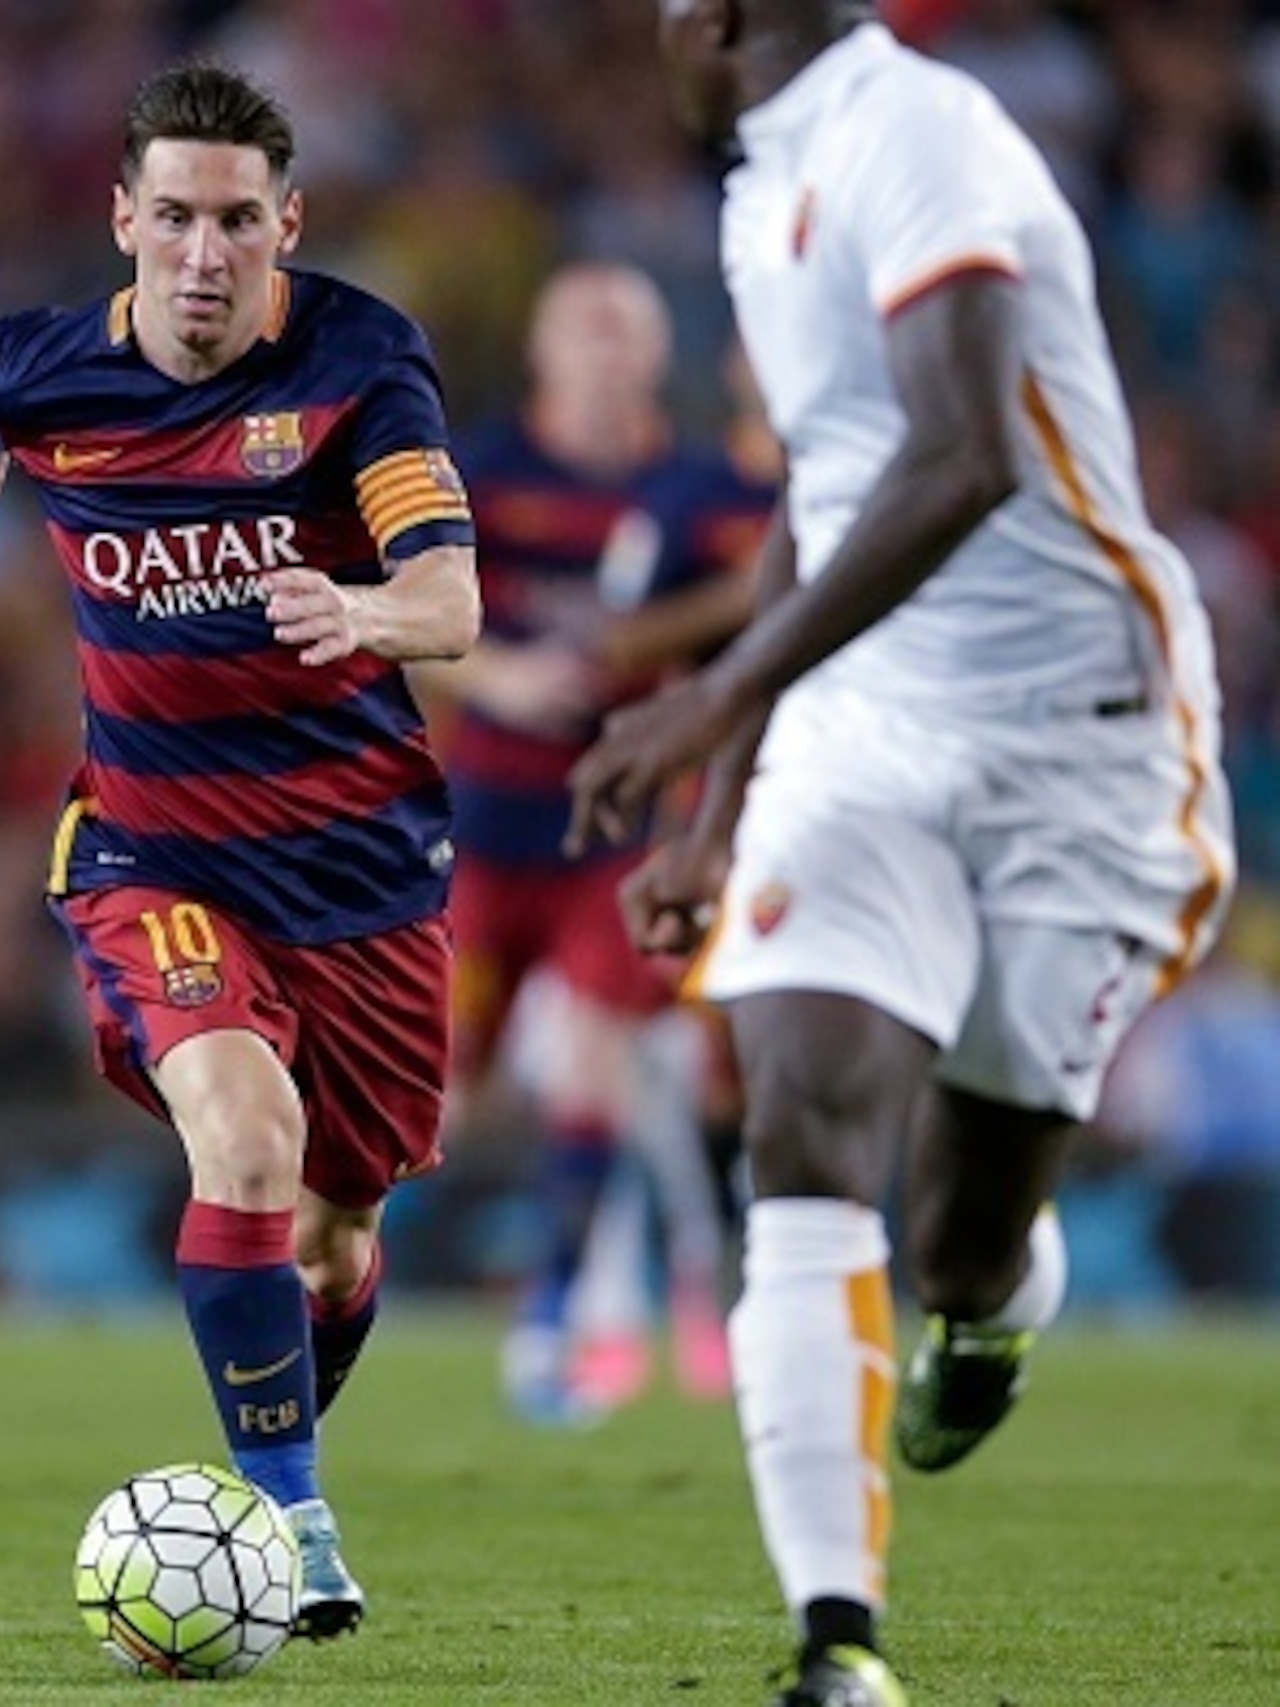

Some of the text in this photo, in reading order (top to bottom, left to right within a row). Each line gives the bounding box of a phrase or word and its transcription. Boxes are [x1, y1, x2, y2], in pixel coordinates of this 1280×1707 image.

[83, 515, 304, 597] QATAR
[136, 574, 270, 622] AIRWA
[140, 902, 221, 972] 10
[237, 1399, 300, 1433] FCB
